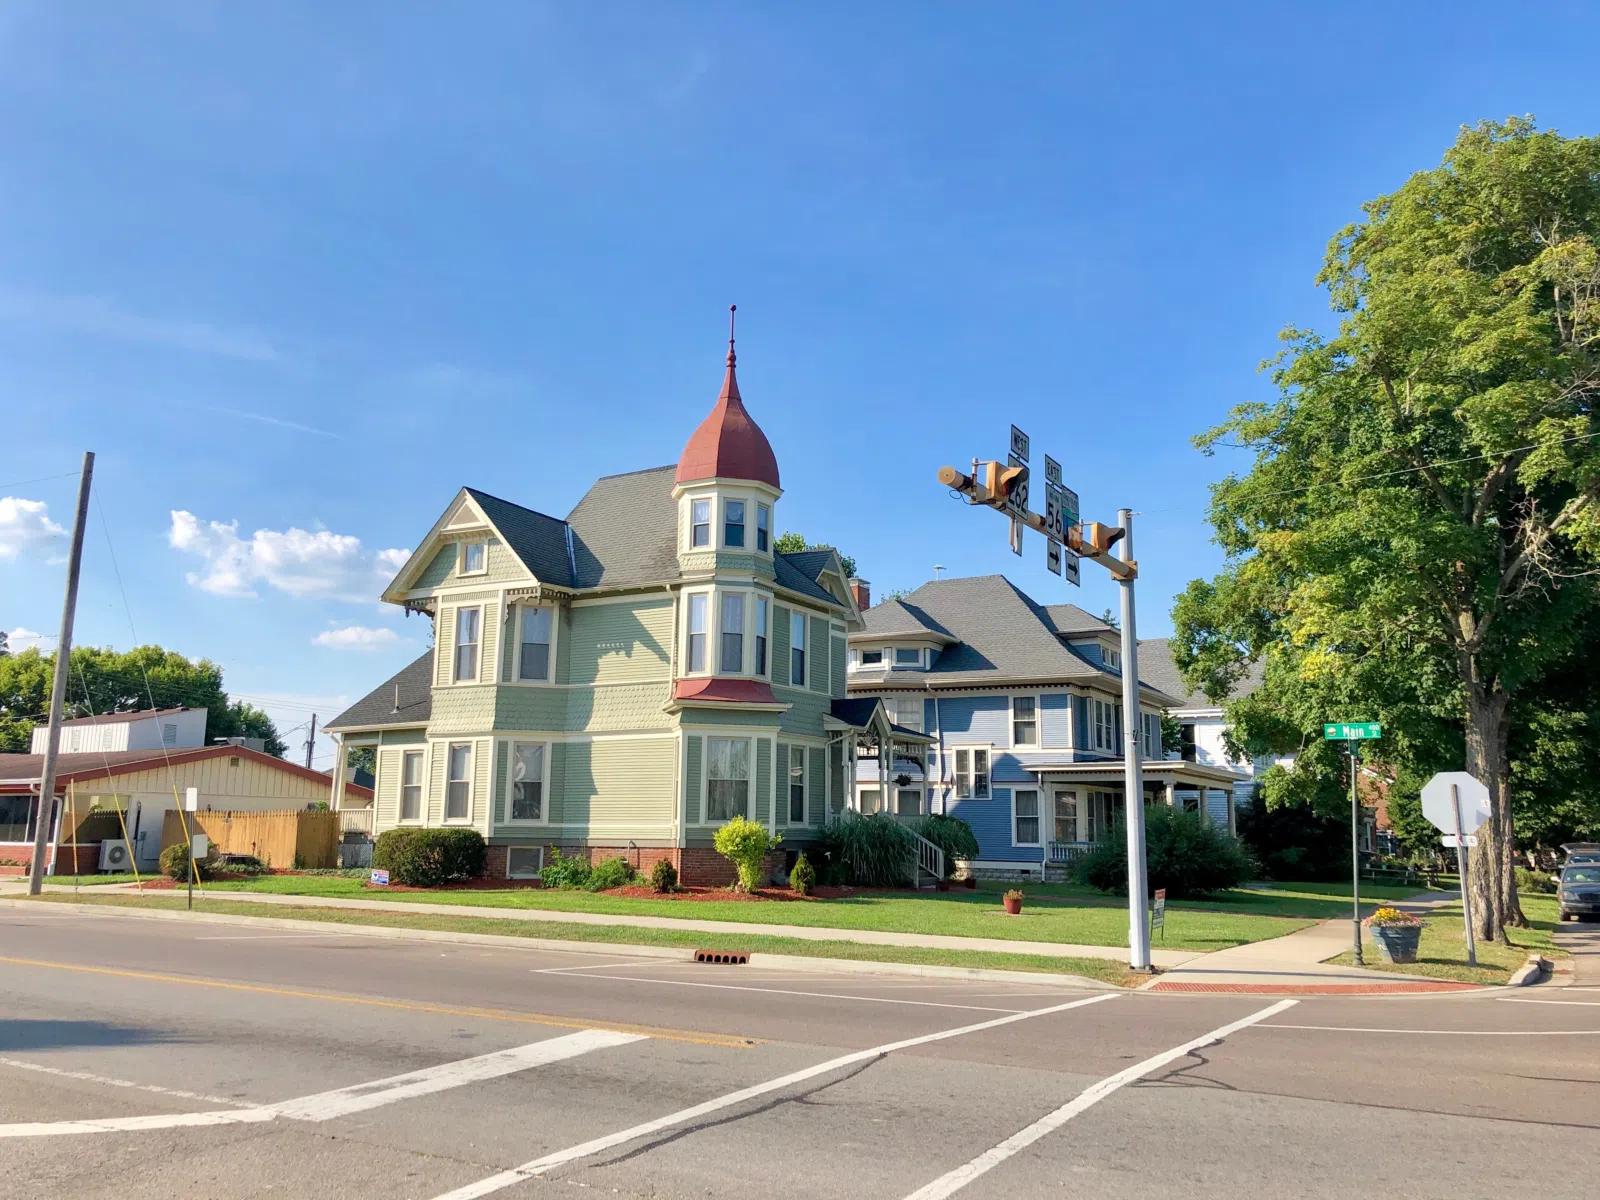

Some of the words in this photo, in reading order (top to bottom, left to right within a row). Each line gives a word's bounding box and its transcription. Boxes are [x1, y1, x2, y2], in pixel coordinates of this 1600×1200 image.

[1014, 432, 1027, 454] WEST
[1047, 462, 1060, 481] EAST
[1048, 501, 1062, 535] 56
[1342, 725, 1364, 737] Main
